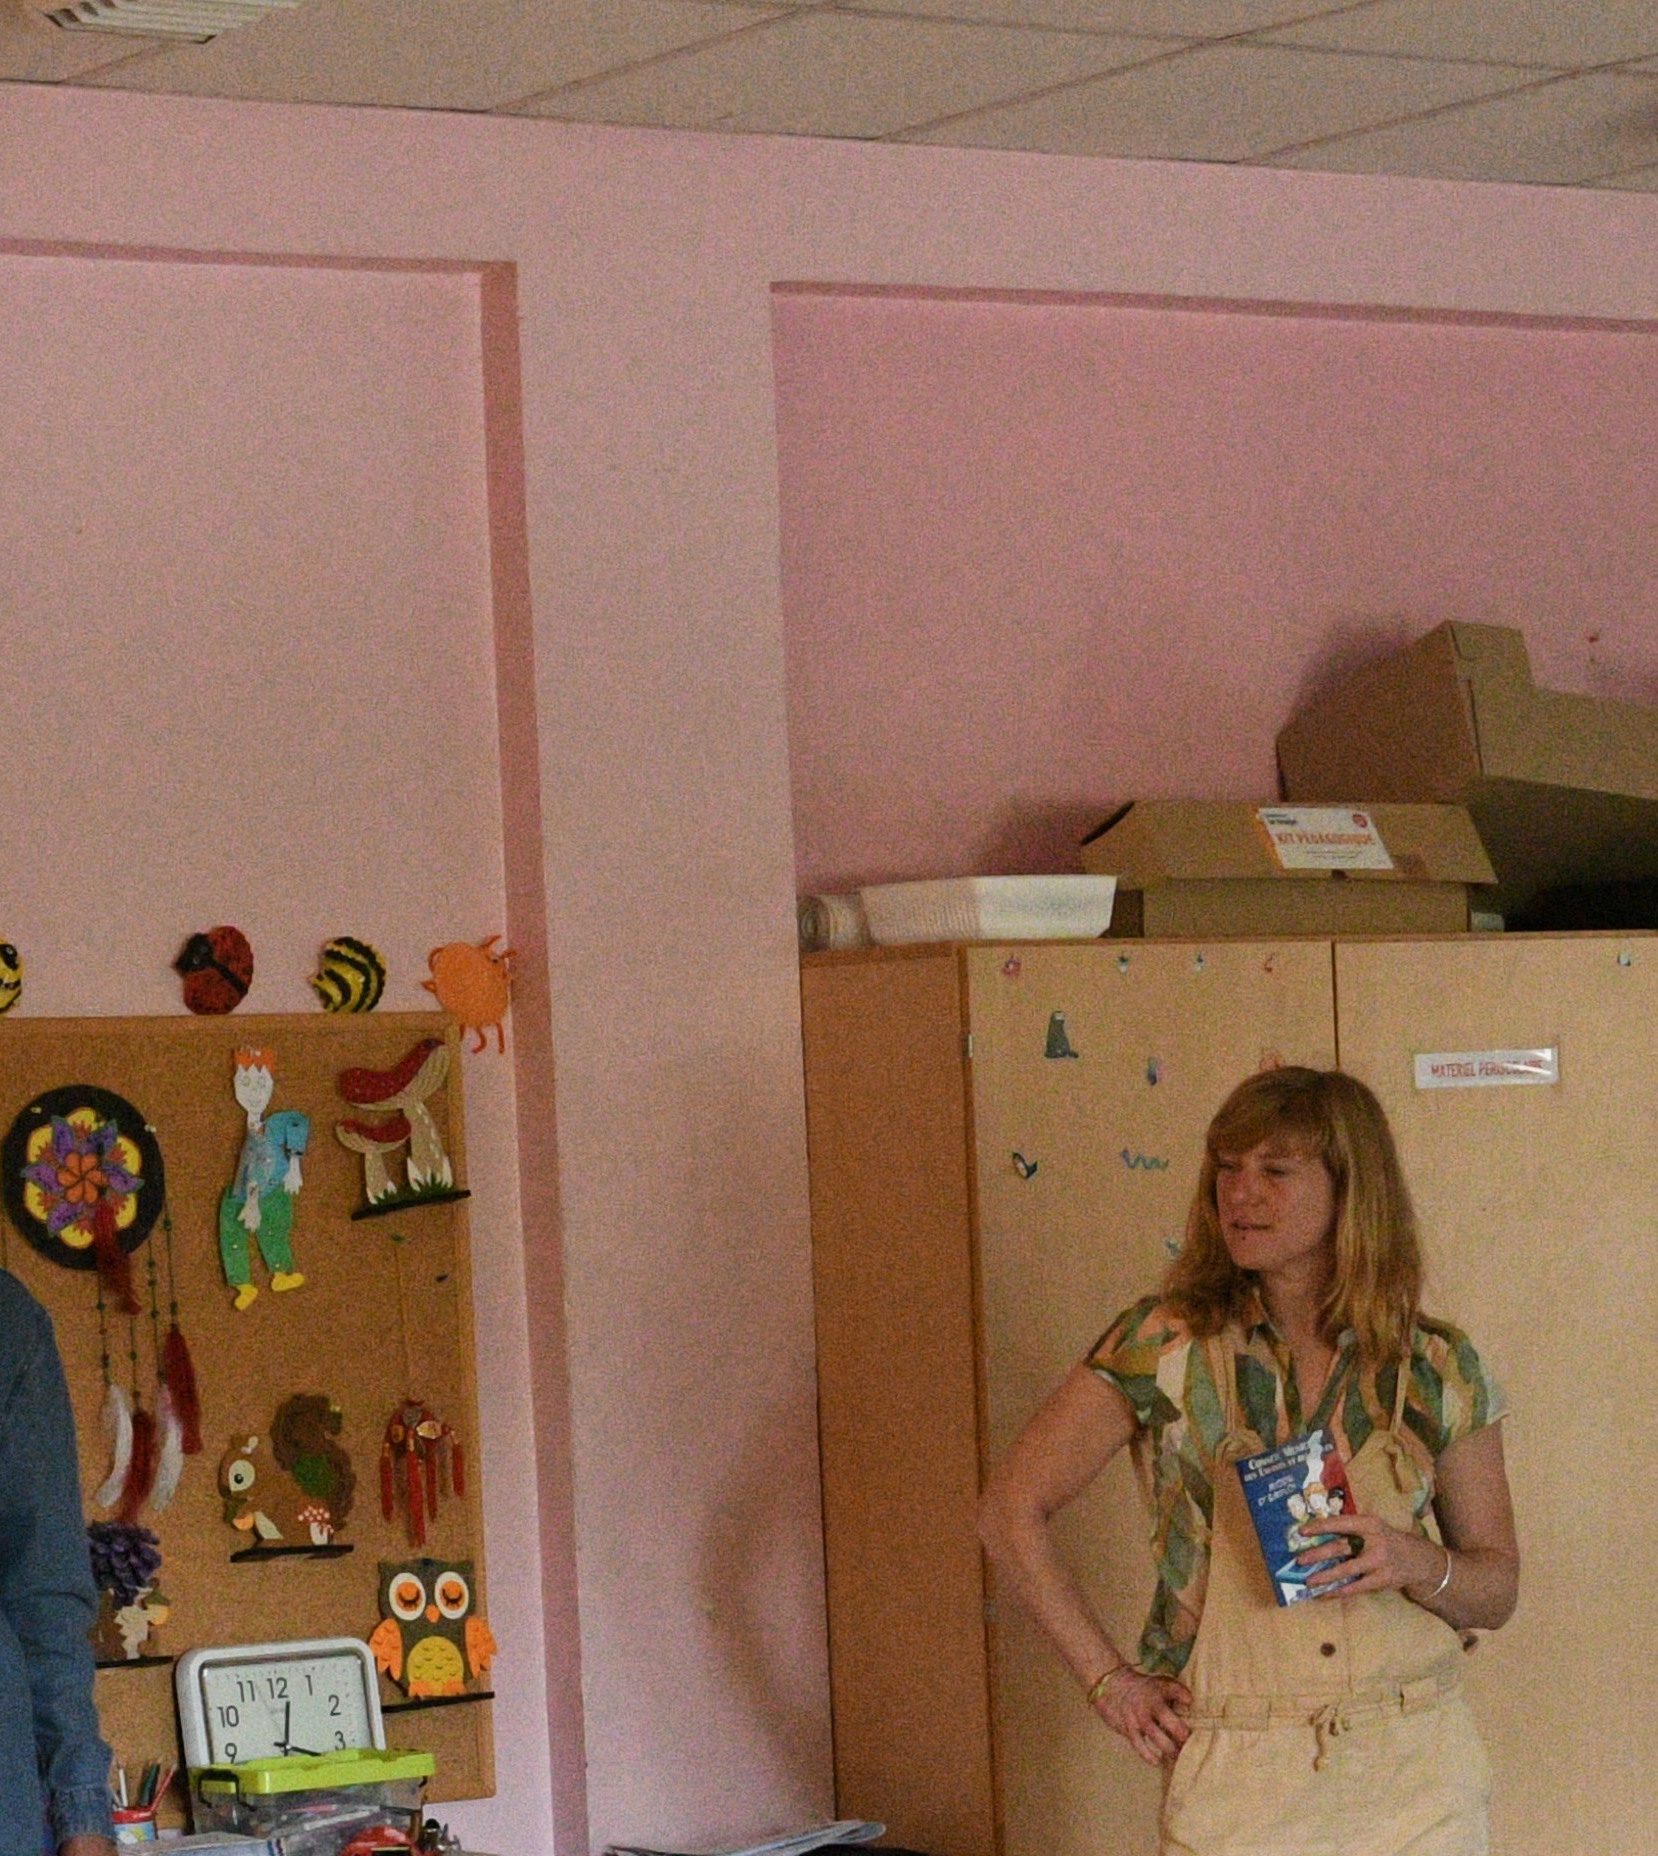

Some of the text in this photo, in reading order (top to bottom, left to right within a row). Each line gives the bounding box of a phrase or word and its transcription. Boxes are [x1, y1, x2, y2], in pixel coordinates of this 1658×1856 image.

[237, 1674, 313, 1702] 11 12 1
[217, 1694, 341, 1728] 10 2
[225, 1730, 346, 1764] 9 3
